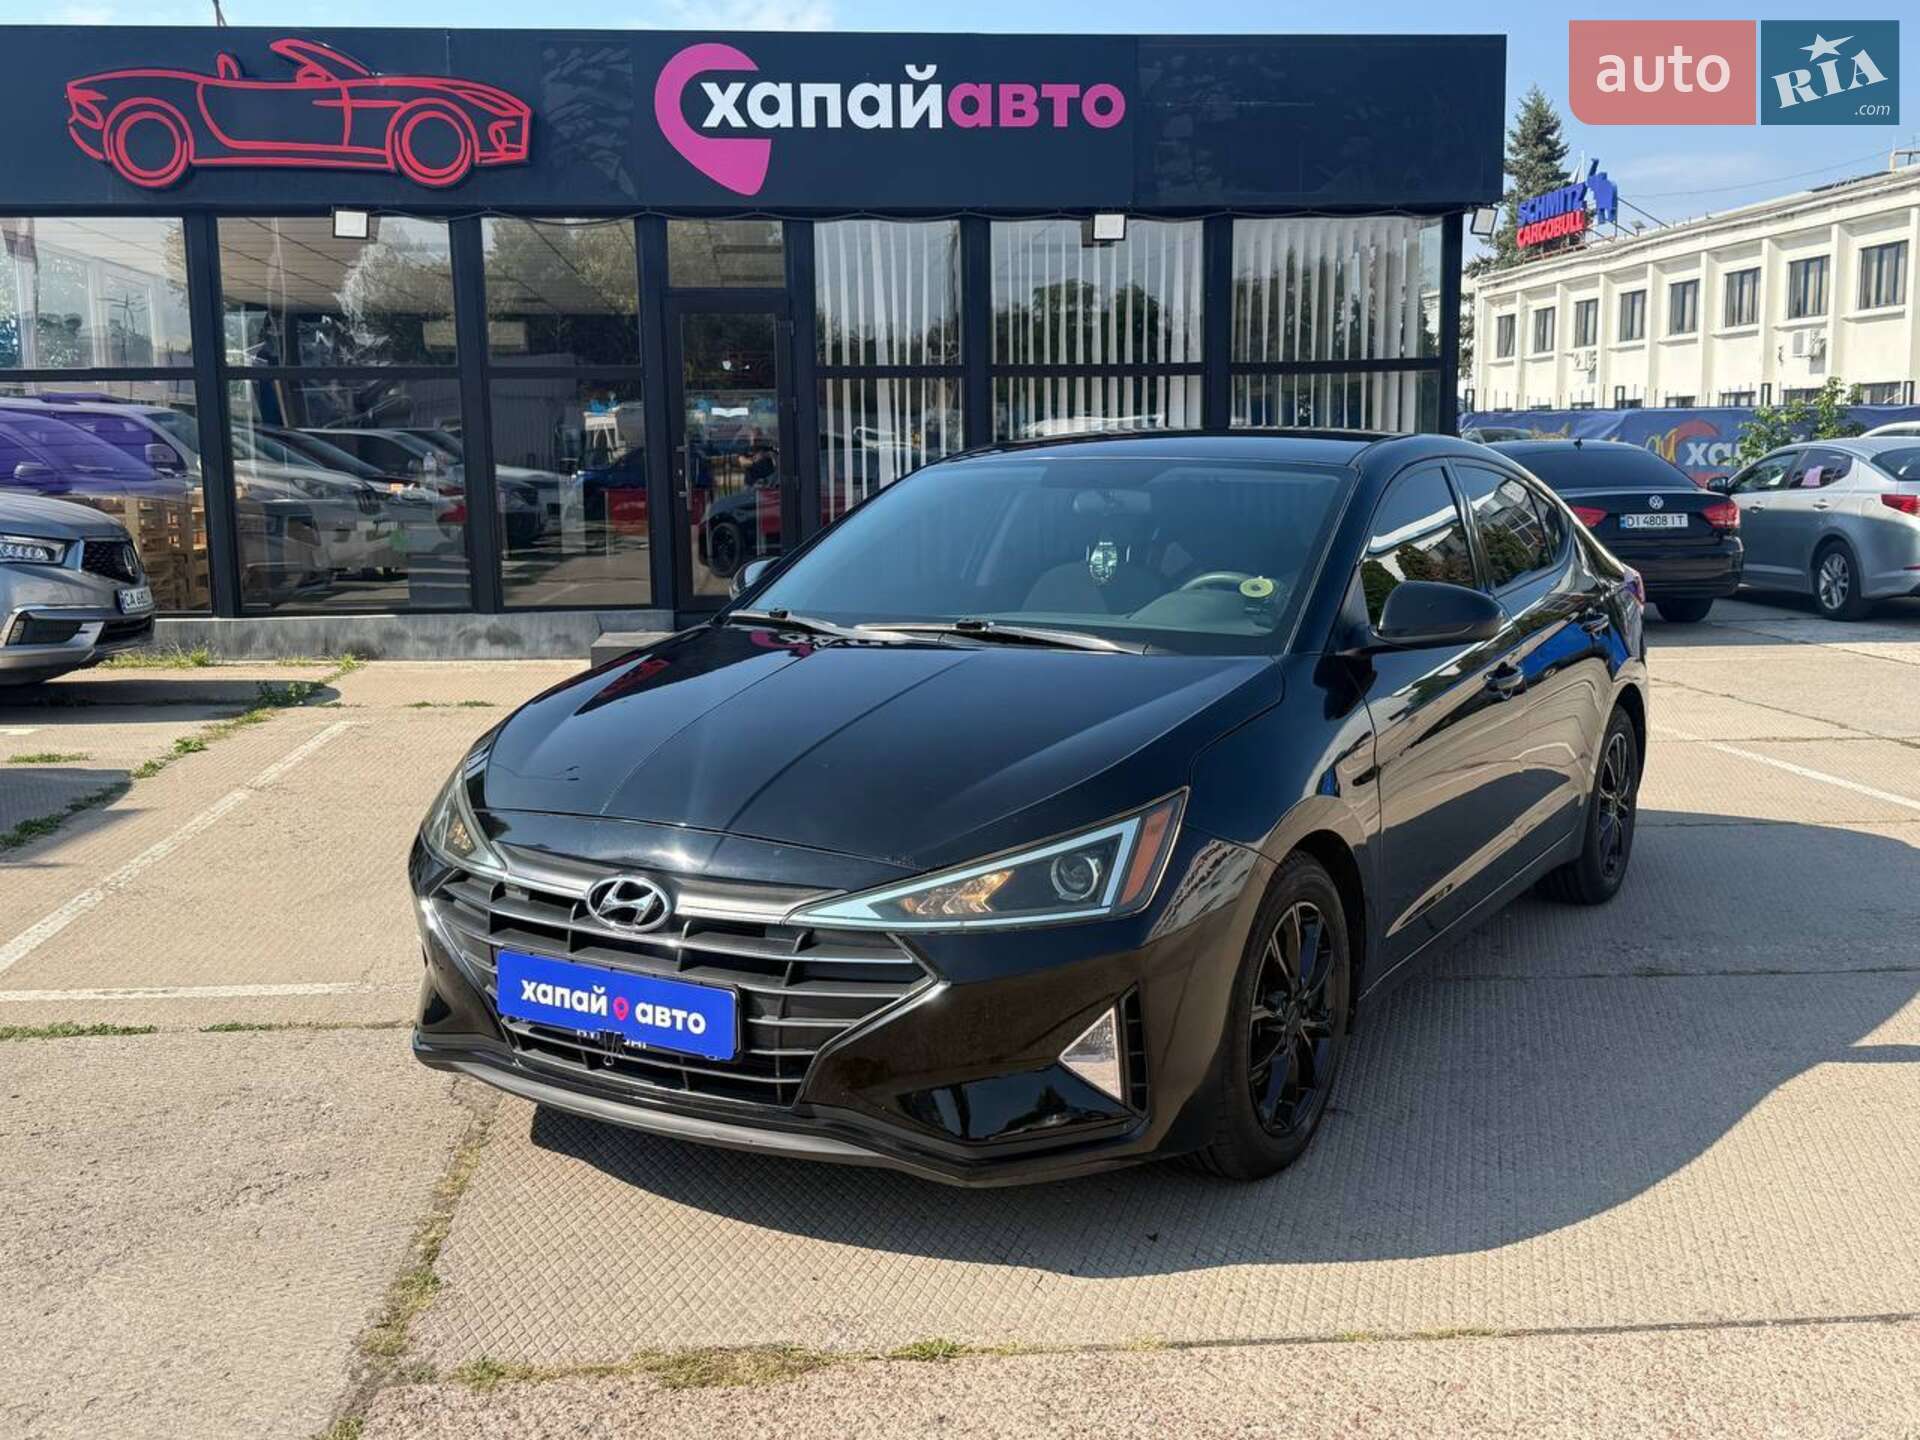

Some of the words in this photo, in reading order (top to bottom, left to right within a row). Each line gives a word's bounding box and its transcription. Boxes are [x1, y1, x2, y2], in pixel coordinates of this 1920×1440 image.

[1518, 182, 1586, 227] SCHMITZ
[1516, 209, 1585, 250] CARGOBULL
[521, 979, 608, 1016] хапай
[635, 1001, 706, 1035] авто
